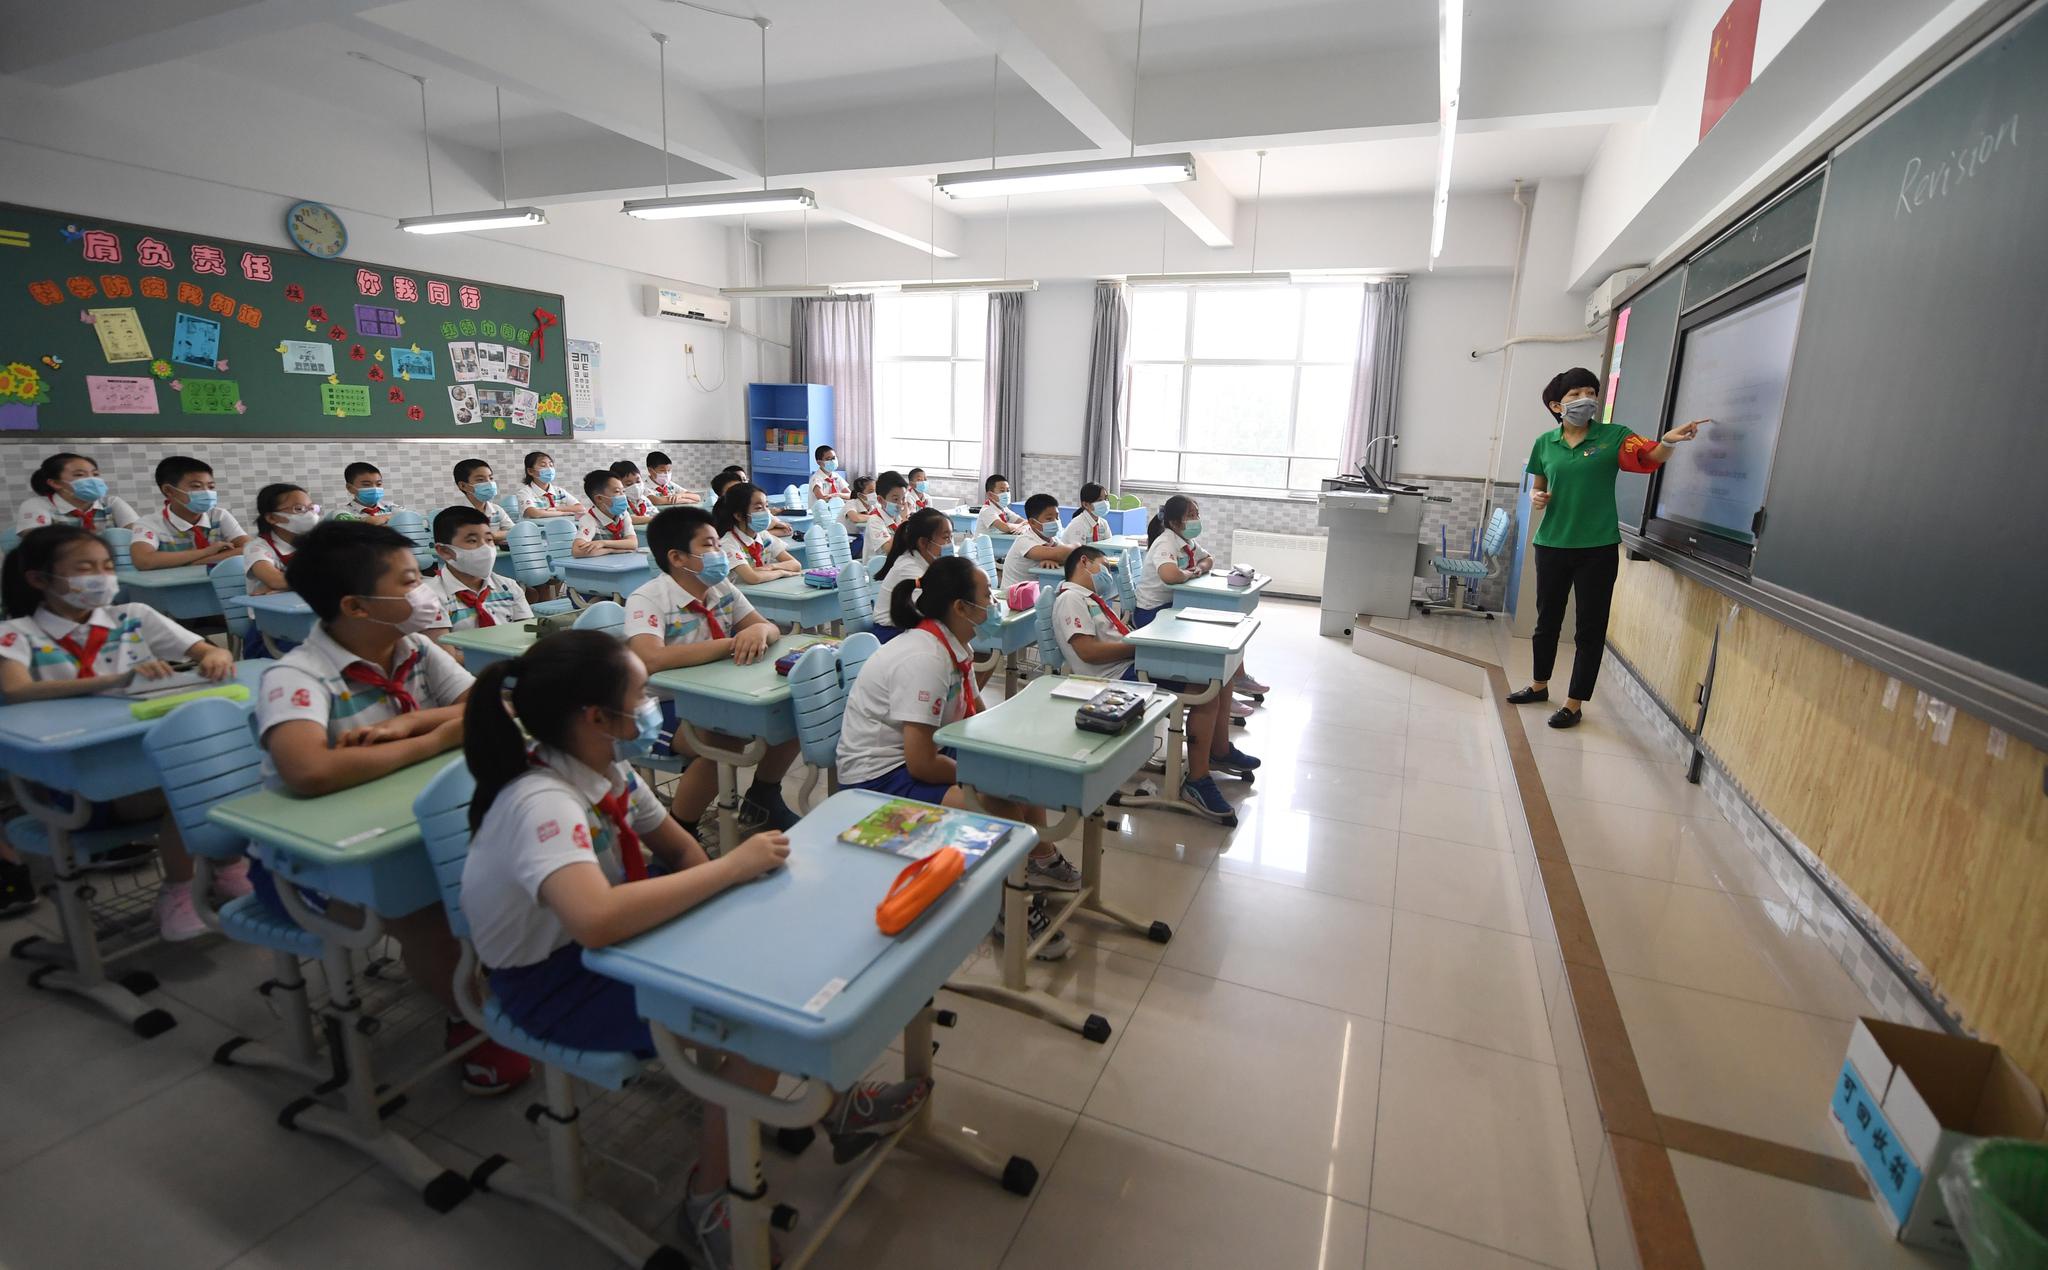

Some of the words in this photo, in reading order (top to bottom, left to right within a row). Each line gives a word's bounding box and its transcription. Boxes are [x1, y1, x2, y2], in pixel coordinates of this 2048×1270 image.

[1895, 113, 2019, 219] Revision
[84, 231, 272, 281] 肩负责任
[357, 269, 480, 310] 你我同行
[1843, 1072, 1907, 1191] 可回收箱
